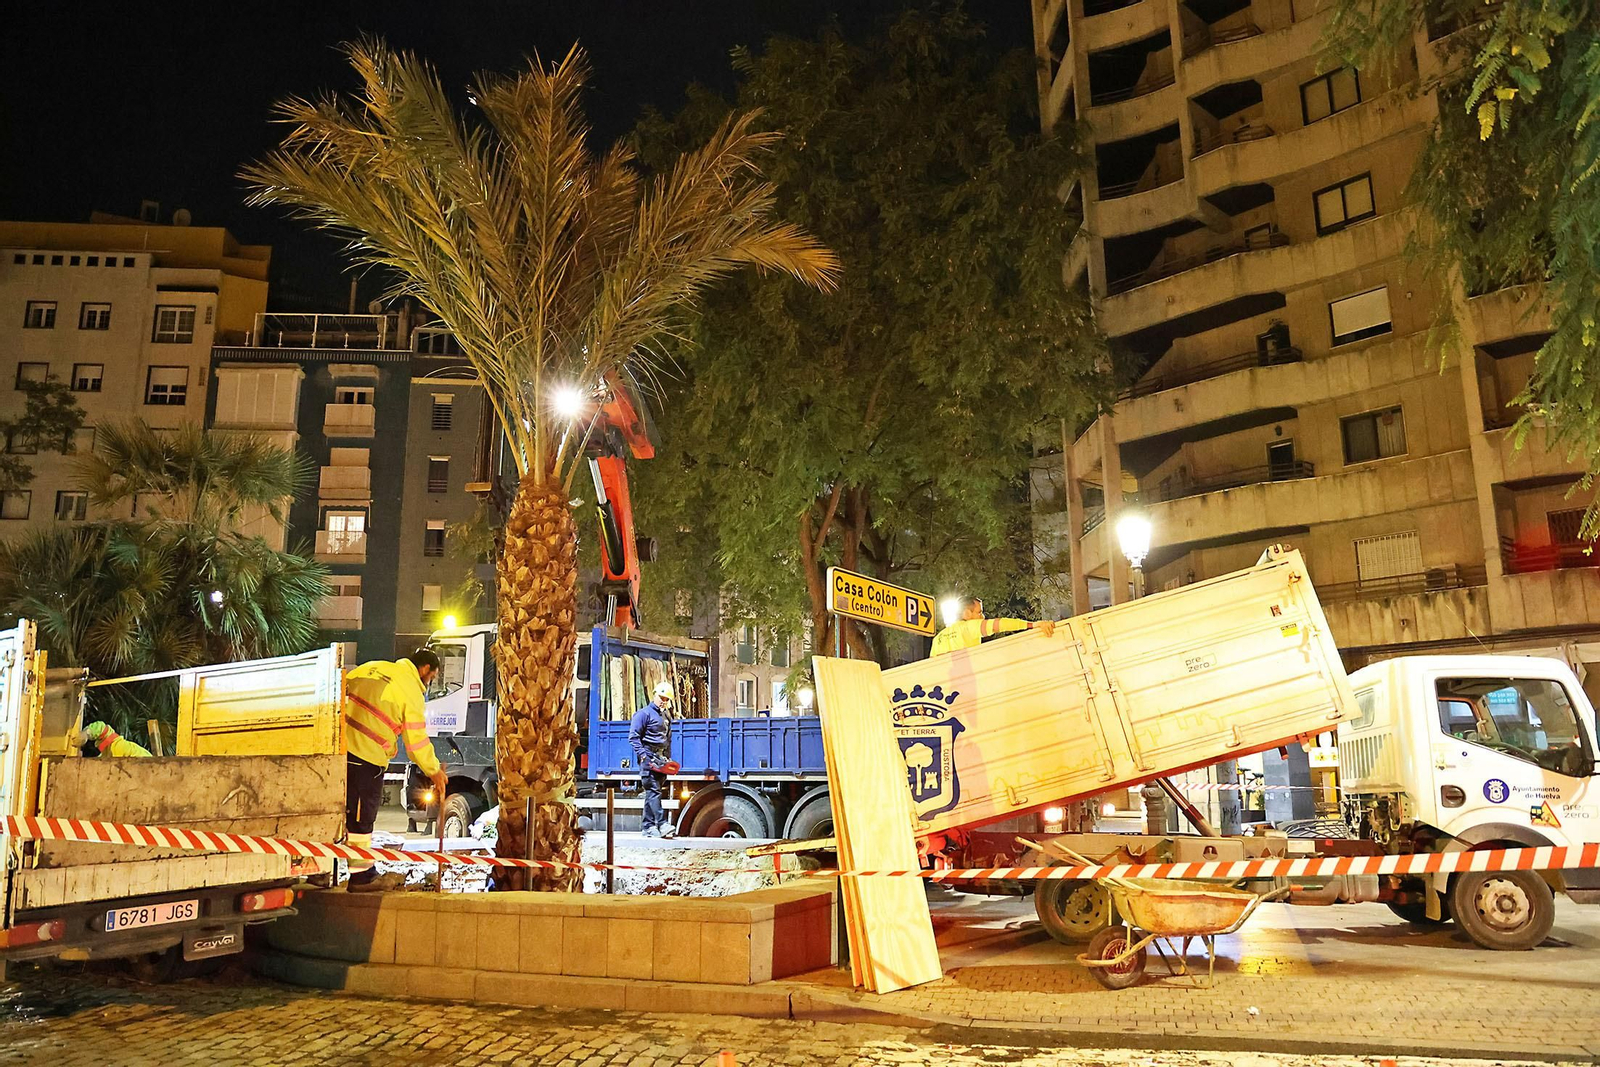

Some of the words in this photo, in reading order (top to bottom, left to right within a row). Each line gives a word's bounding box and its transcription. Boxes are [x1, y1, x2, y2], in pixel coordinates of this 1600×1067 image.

[835, 576, 863, 598] Casa
[867, 585, 898, 607] Colón
[851, 598, 884, 618] (centro)
[907, 597, 918, 623] P
[1185, 656, 1202, 666] pre
[1187, 662, 1210, 673] zero
[900, 728, 909, 736] ET
[1562, 804, 1582, 812] pre
[1564, 811, 1590, 819] zero
[119, 907, 157, 927] 6781
[166, 903, 194, 920] JGS
